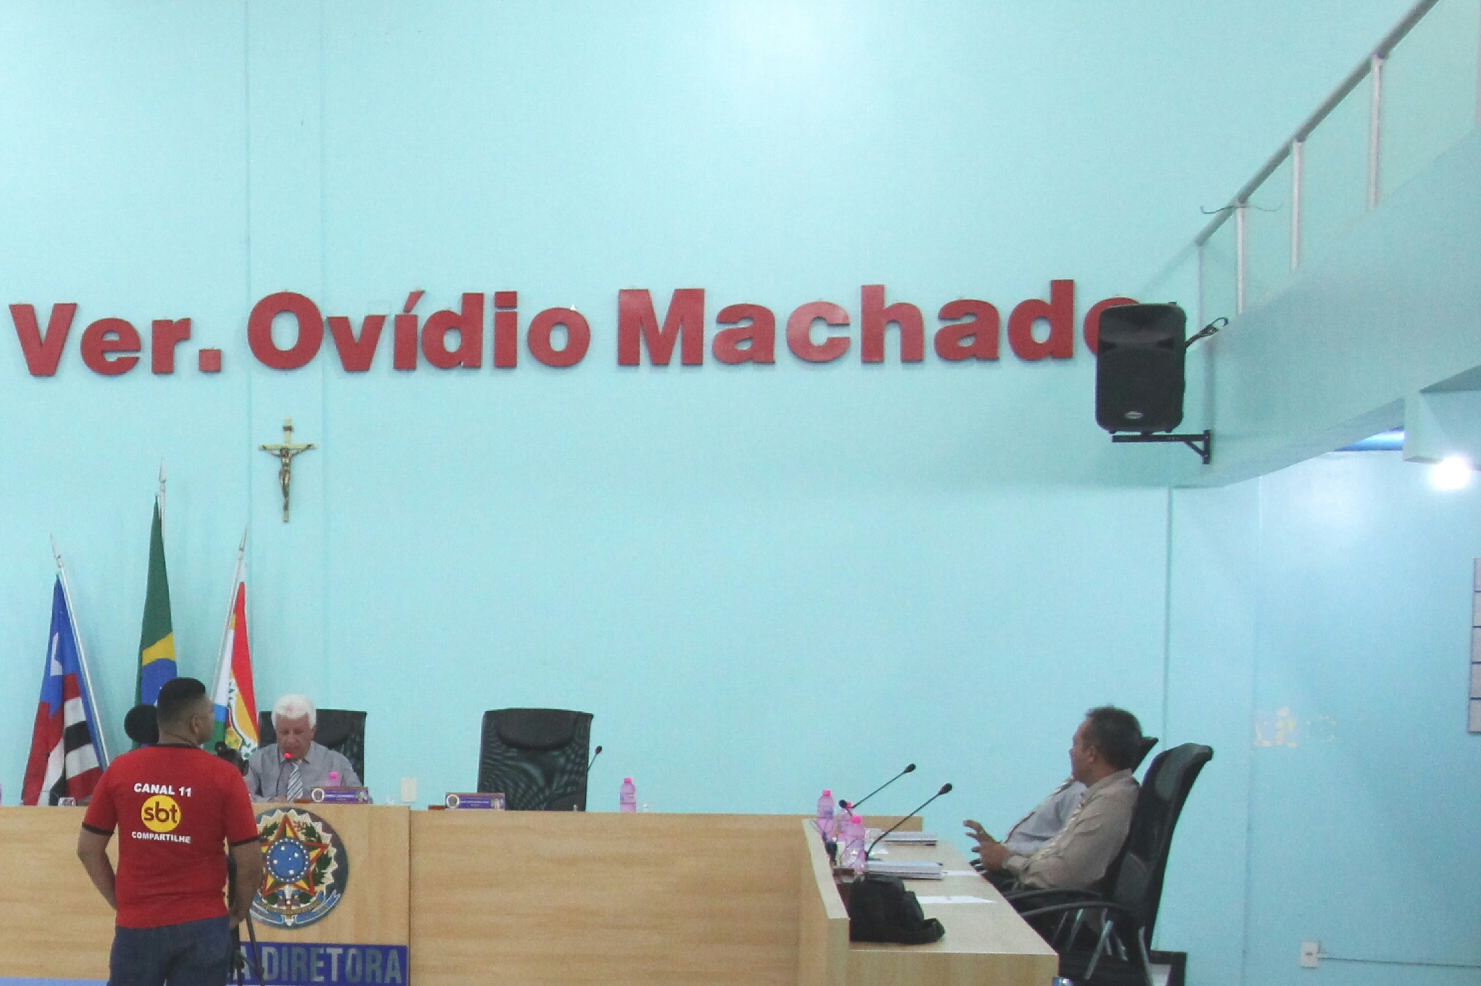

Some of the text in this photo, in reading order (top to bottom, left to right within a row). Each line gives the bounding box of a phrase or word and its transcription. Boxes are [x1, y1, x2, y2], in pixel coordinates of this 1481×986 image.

[9, 302, 222, 375] Ver.
[247, 290, 592, 371] Ovídio
[618, 279, 1137, 366] Machad
[133, 783, 192, 797] CANAL 11
[143, 801, 178, 824] sbt
[131, 831, 191, 844] COMPARTILHE
[262, 946, 403, 985] DIRETORA
